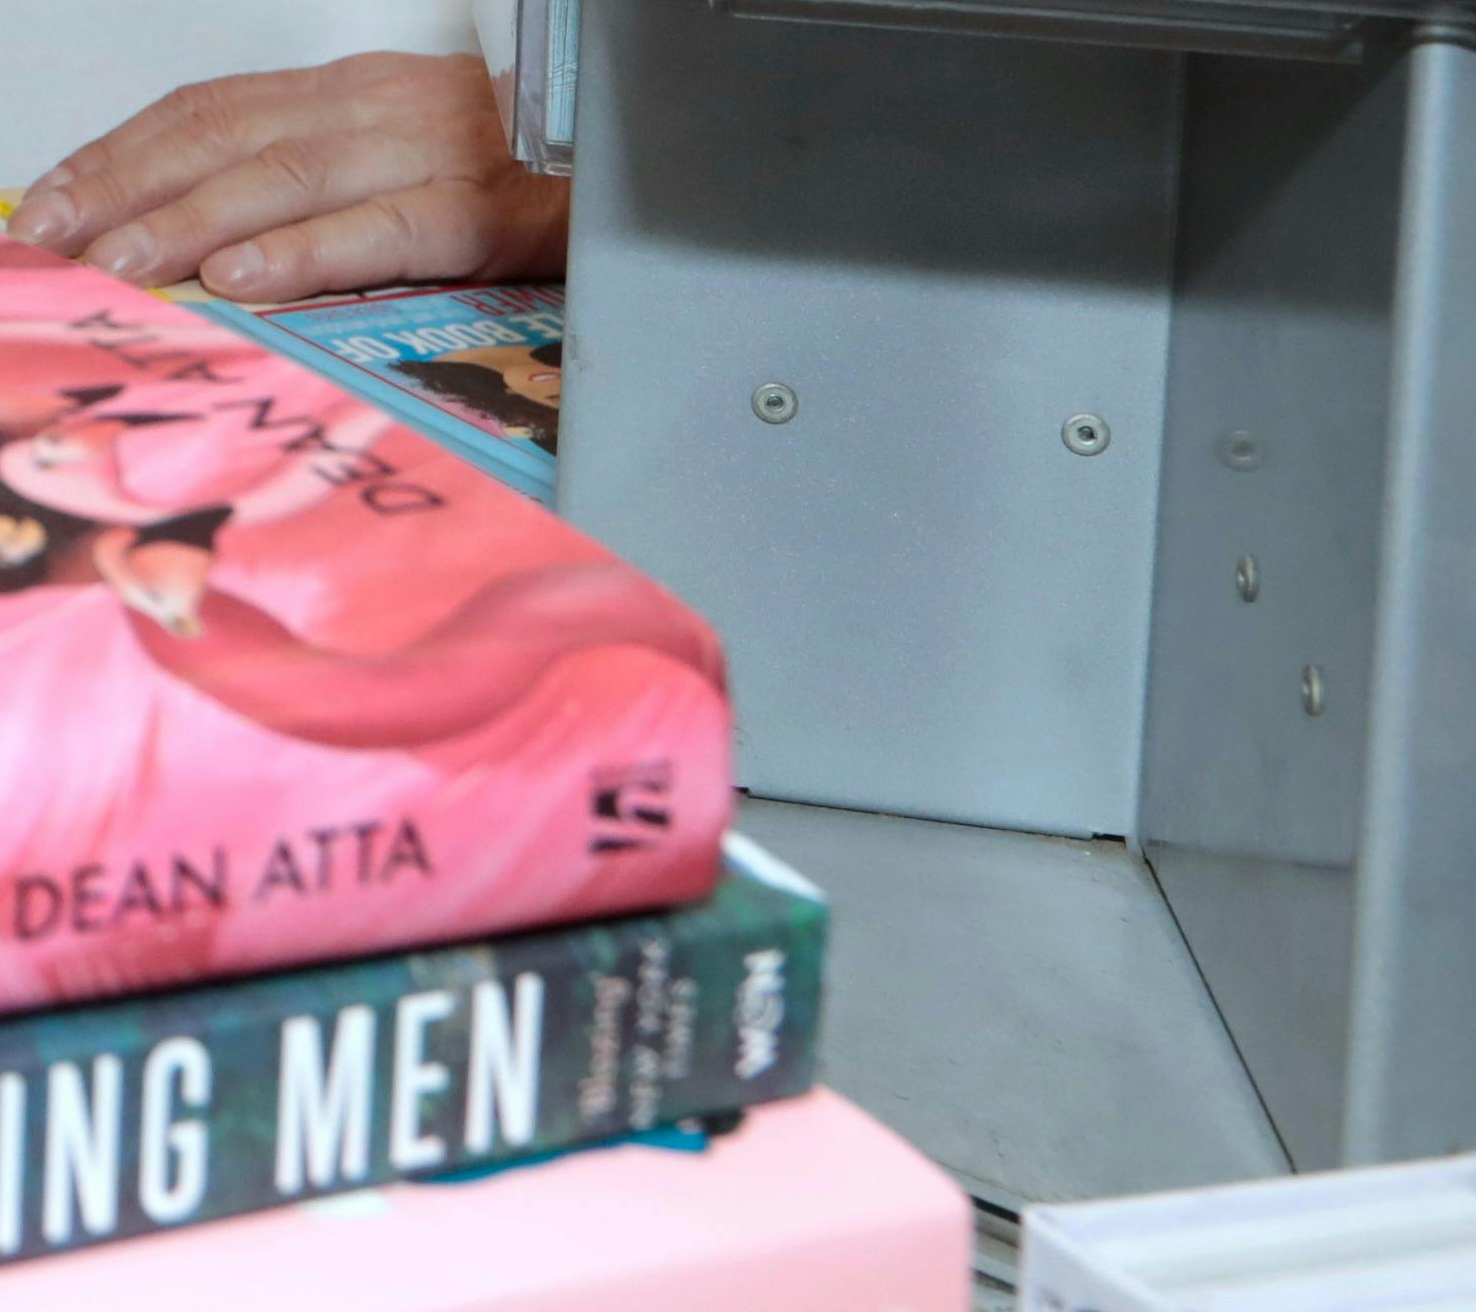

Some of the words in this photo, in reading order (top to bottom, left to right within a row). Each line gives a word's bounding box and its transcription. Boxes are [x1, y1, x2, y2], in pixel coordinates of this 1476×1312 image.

[56, 307, 244, 387] ATTA
[332, 336, 393, 363] OF
[387, 317, 527, 356] BOOK
[211, 395, 447, 515] DEAN
[12, 839, 242, 946] DEAN
[253, 817, 437, 911] ATTA
[271, 972, 547, 1198] MEN
